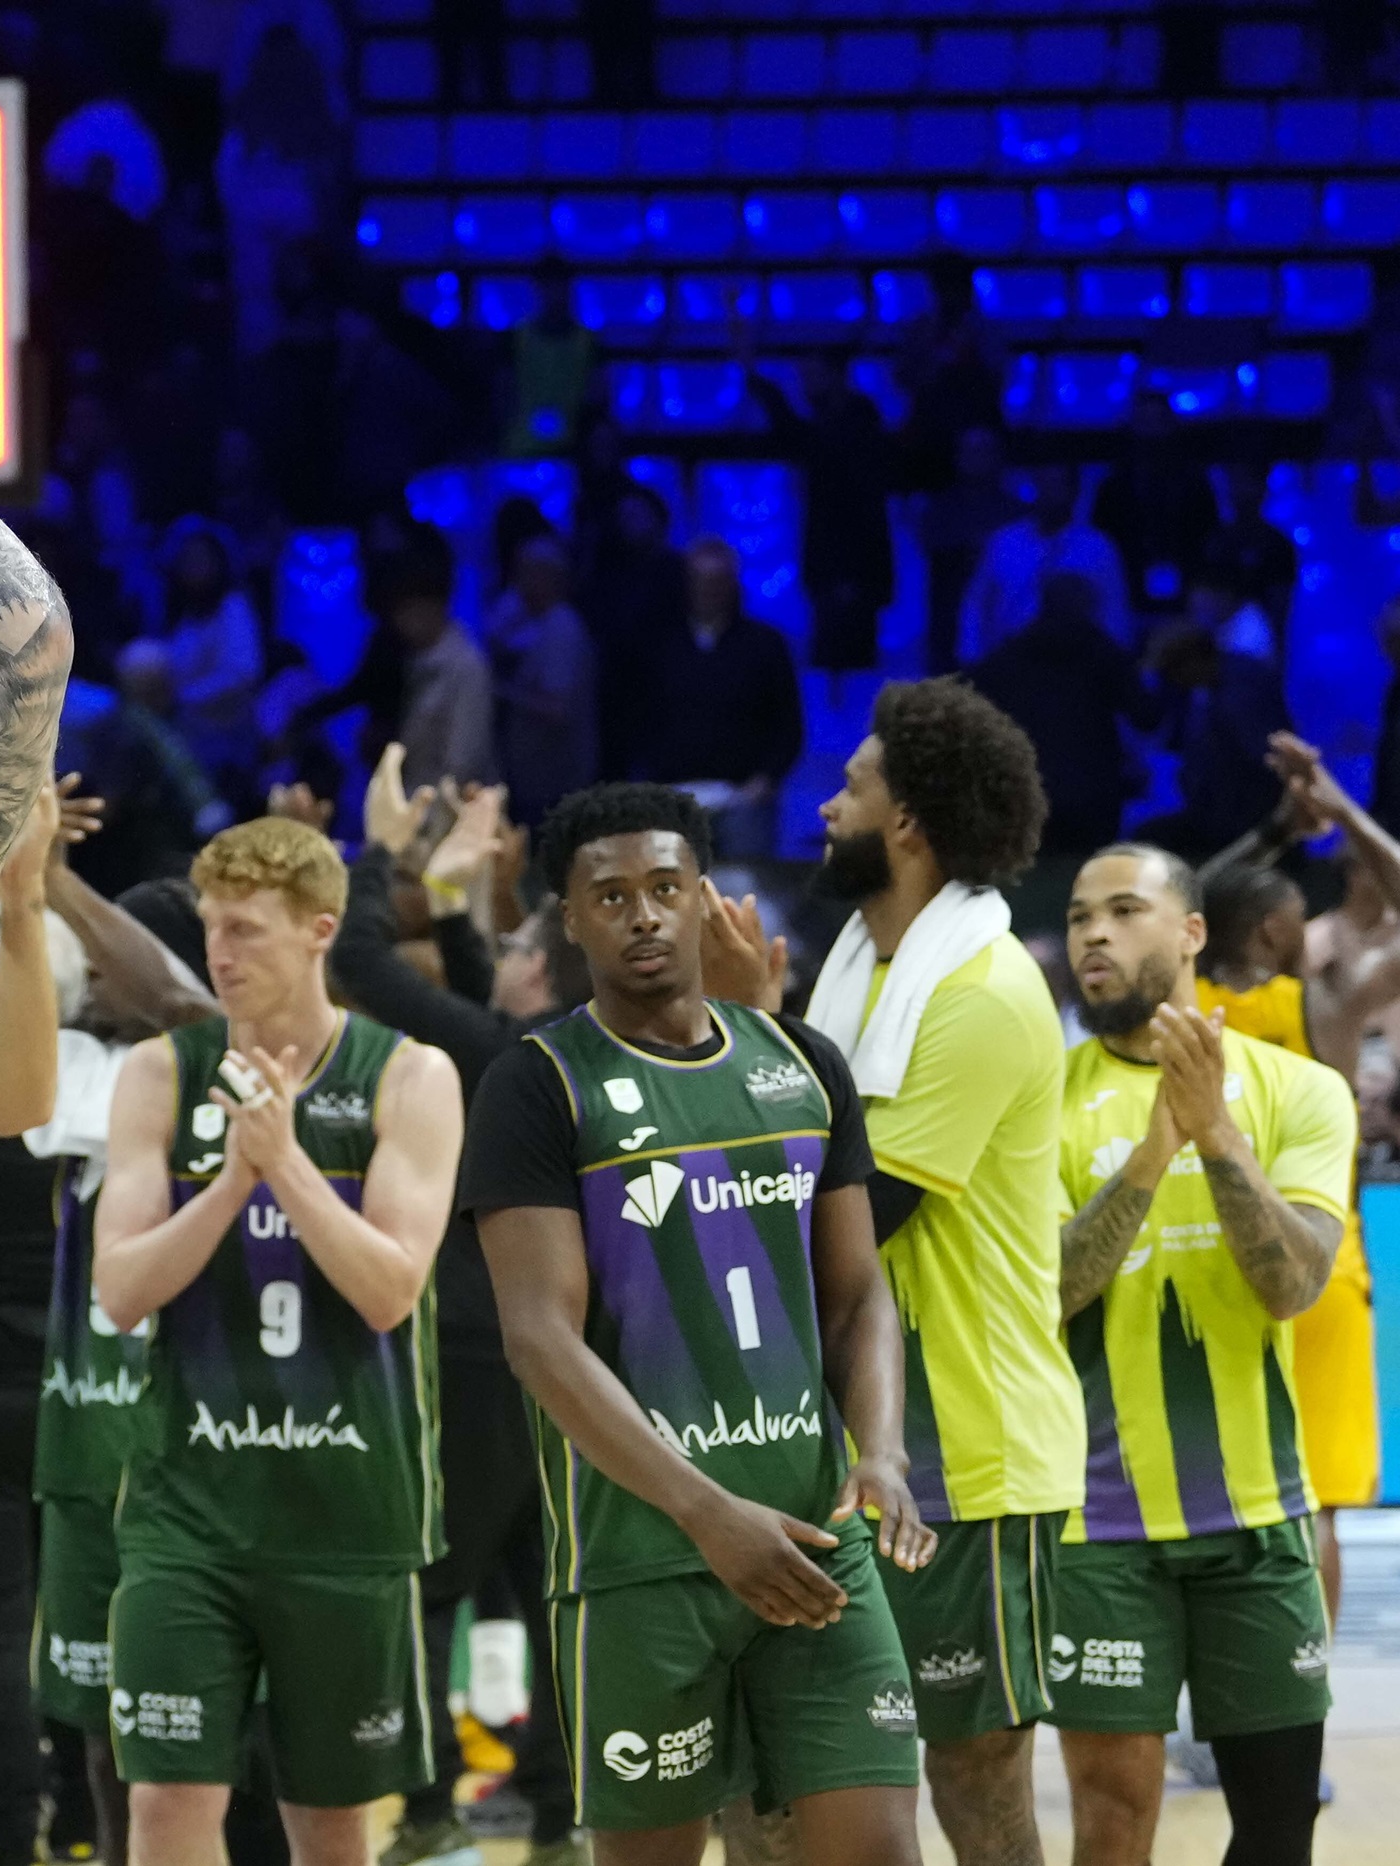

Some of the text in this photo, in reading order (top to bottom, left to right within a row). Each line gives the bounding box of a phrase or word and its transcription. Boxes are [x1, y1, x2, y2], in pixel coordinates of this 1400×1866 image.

[690, 1162, 815, 1214] Unicaja
[259, 1280, 302, 1358] 9
[725, 1266, 761, 1350] 1
[188, 1400, 369, 1453] Andalucía
[1083, 1638, 1145, 1659] COSTA
[657, 1715, 714, 1752] COSTA
[657, 1748, 692, 1767] DEL
